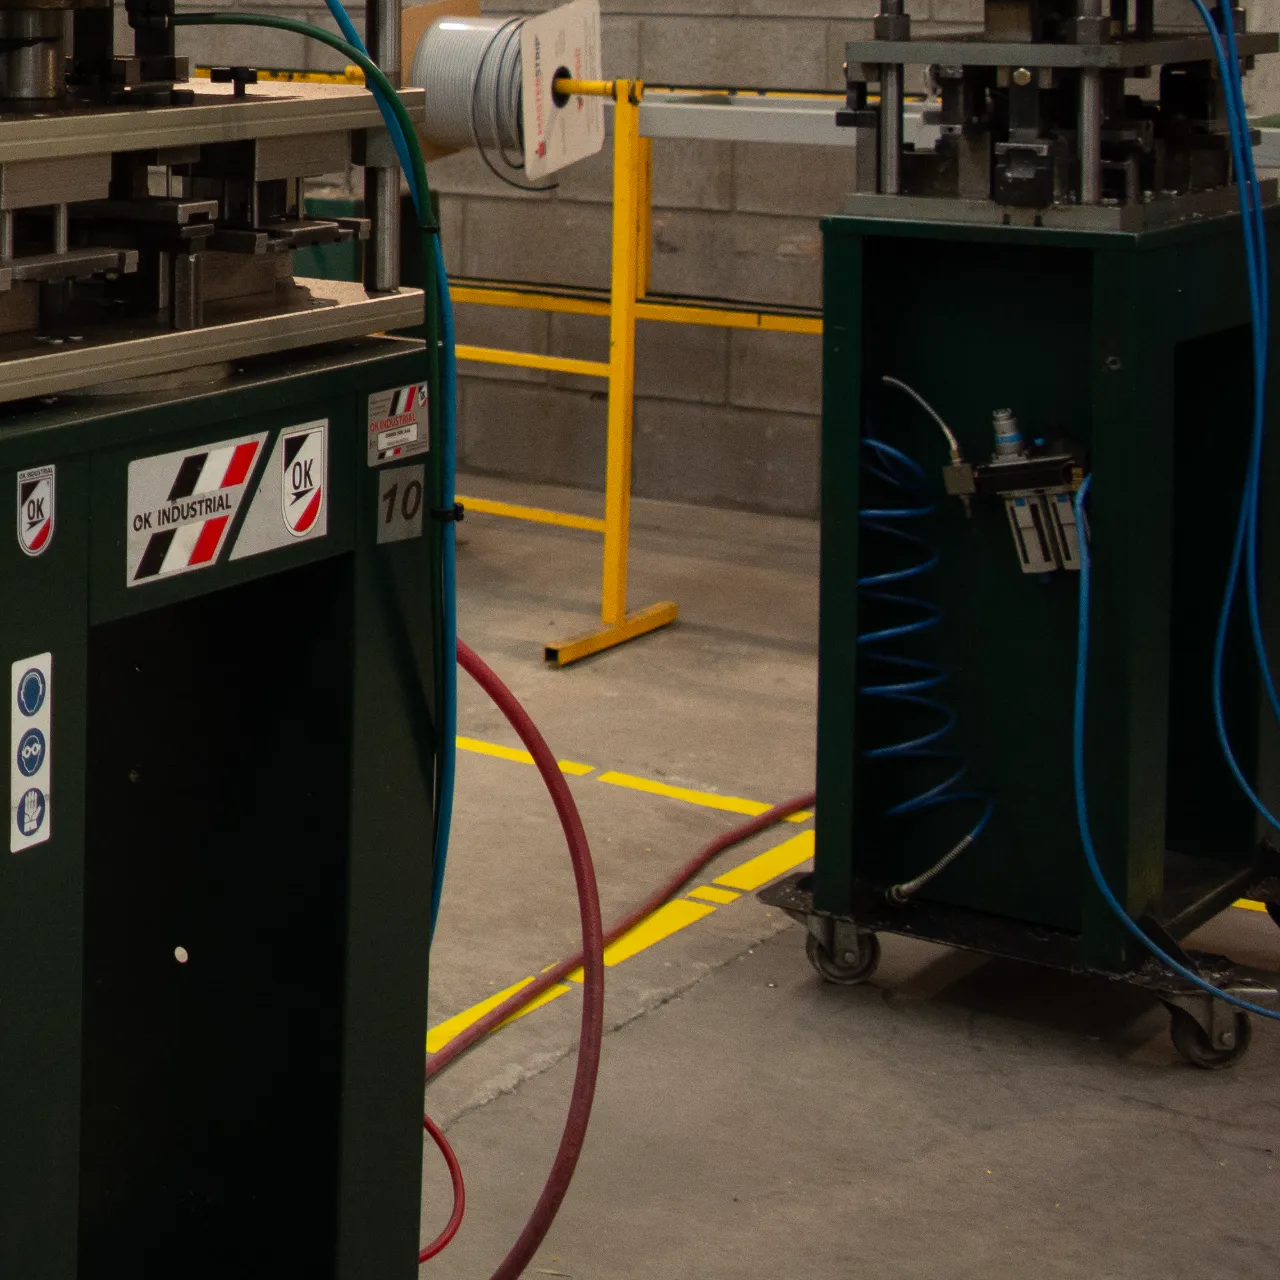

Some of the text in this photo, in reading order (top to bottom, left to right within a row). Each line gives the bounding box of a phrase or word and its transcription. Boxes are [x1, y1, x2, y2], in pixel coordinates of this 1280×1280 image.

[292, 458, 314, 491] OK
[27, 497, 45, 520] OK
[133, 493, 232, 532] OK INDUSTRIAL
[383, 480, 422, 524] 10
